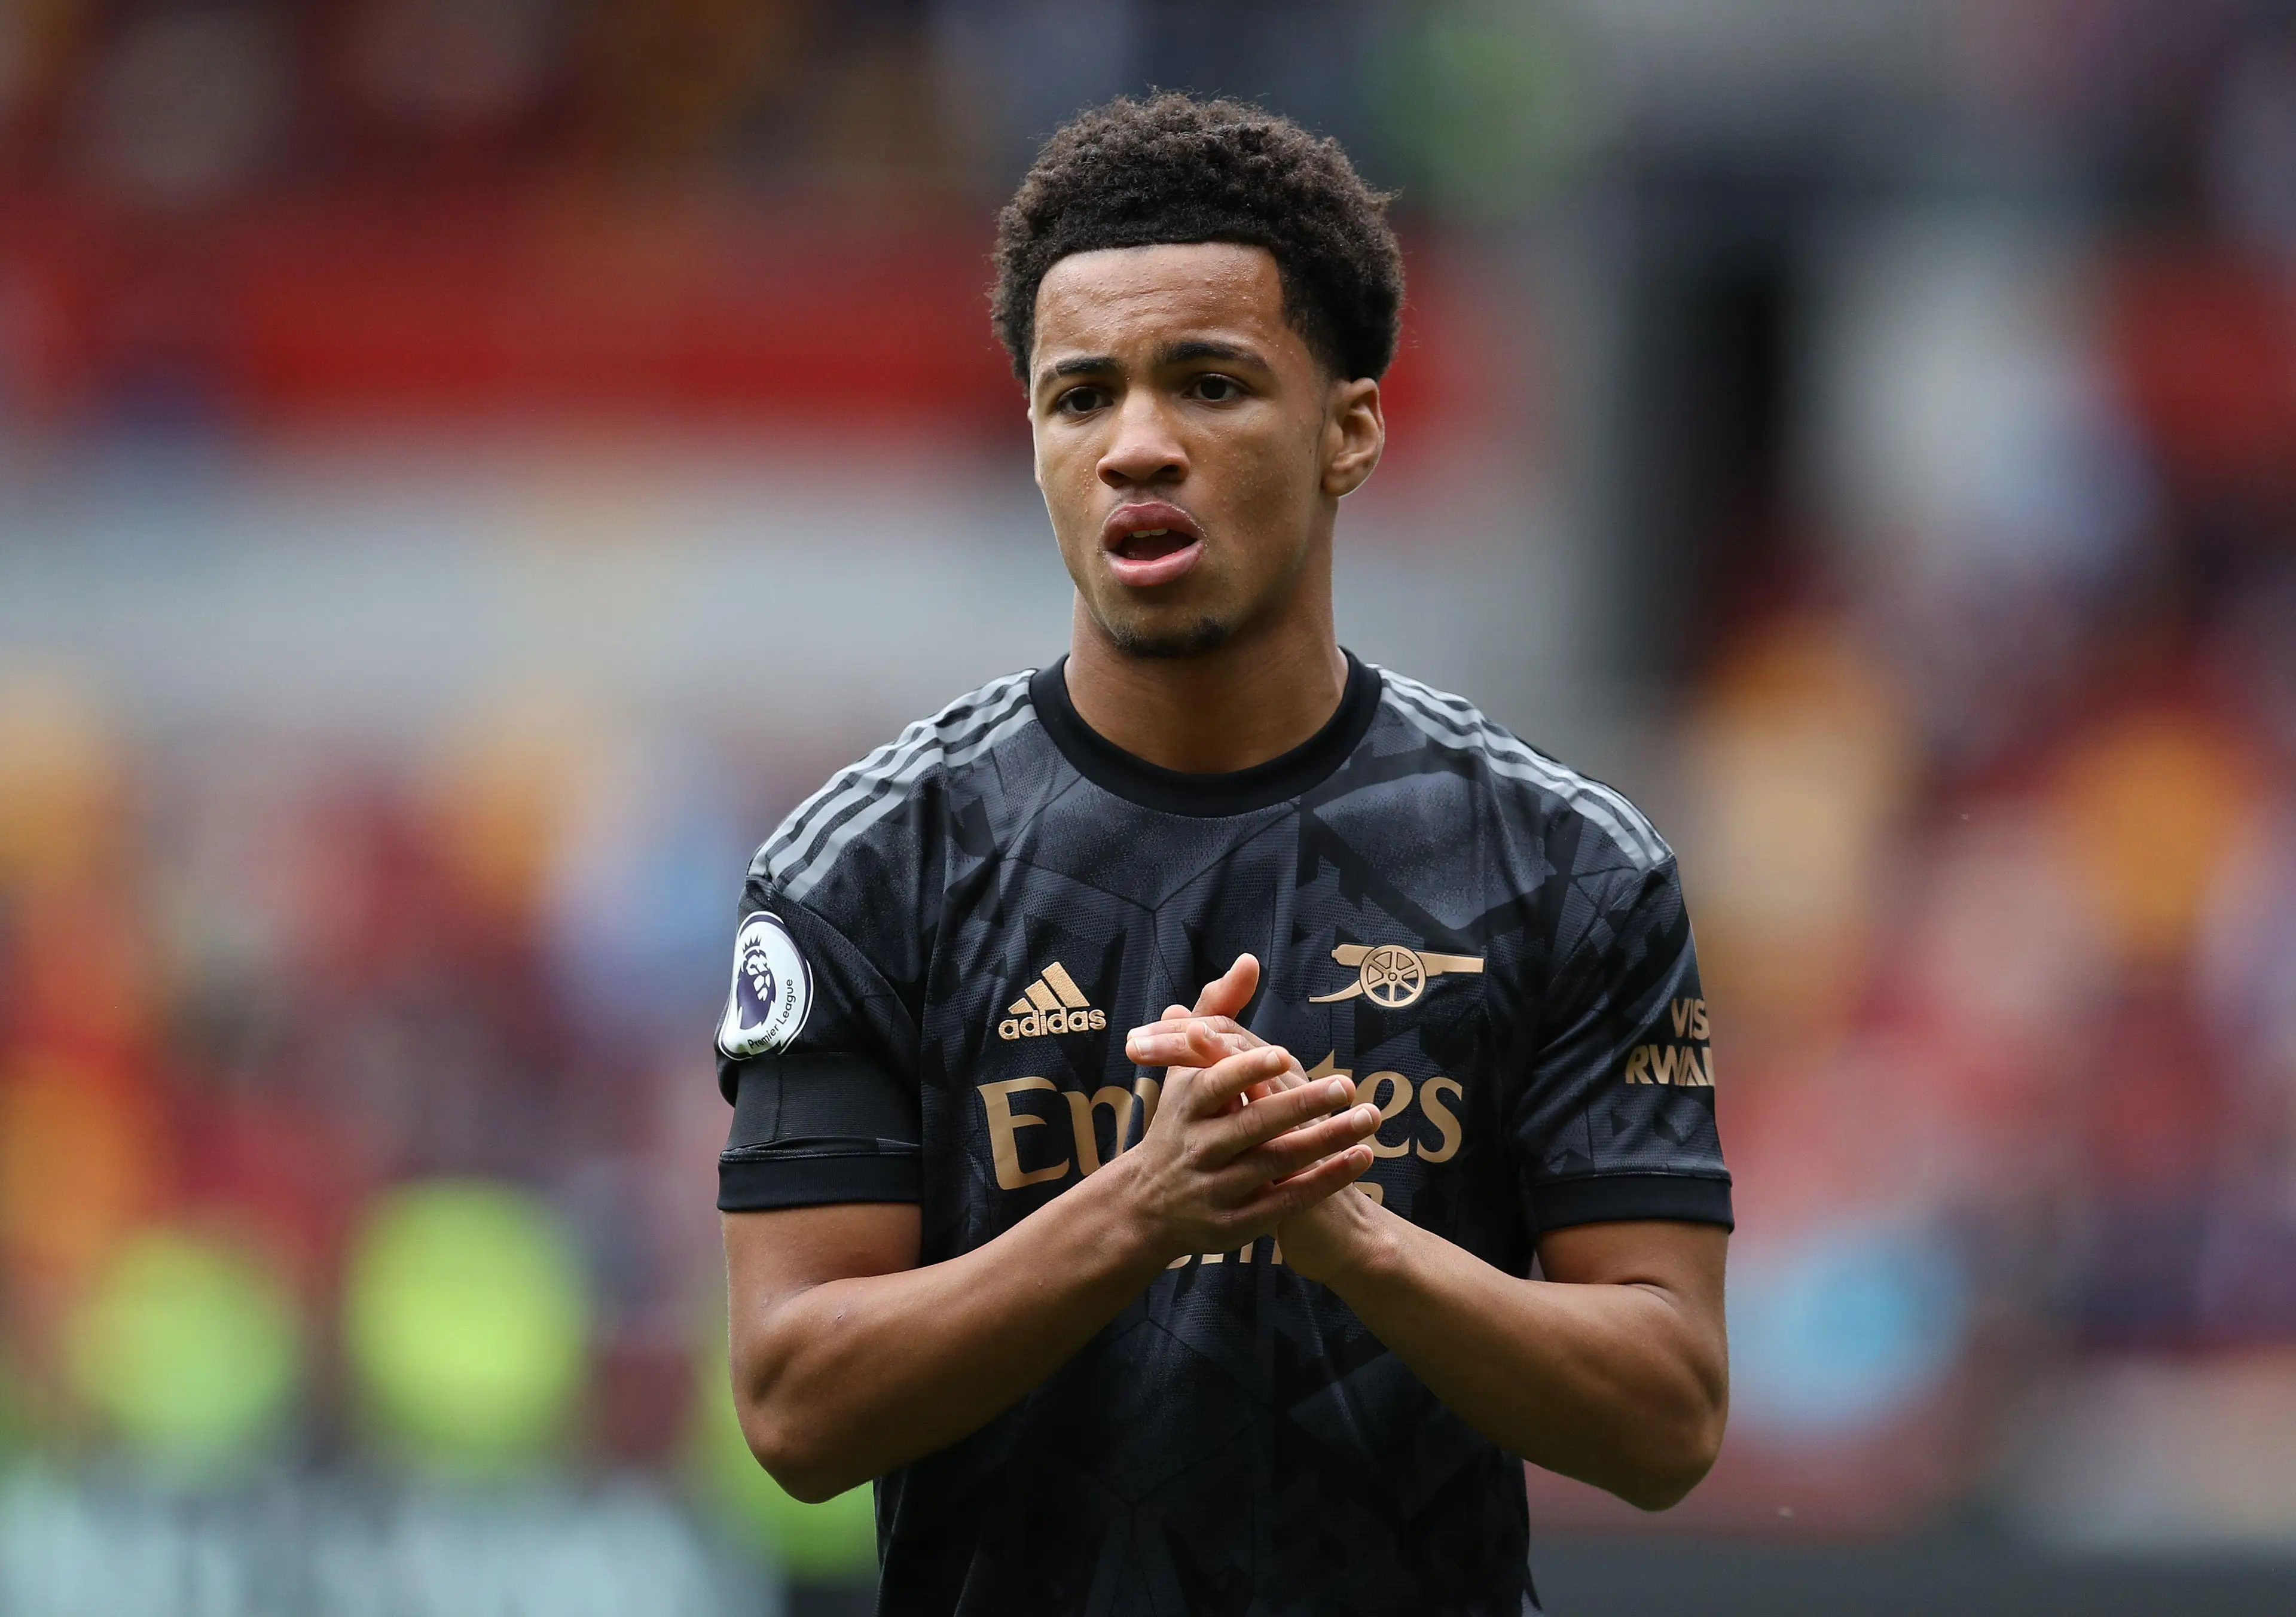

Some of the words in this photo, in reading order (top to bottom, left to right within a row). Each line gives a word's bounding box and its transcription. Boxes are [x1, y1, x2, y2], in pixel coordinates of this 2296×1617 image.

[747, 1025, 779, 1049] Premier
[776, 978, 796, 1025] League
[998, 1006, 1107, 1041] adidas
[1671, 997, 1710, 1040] VIS
